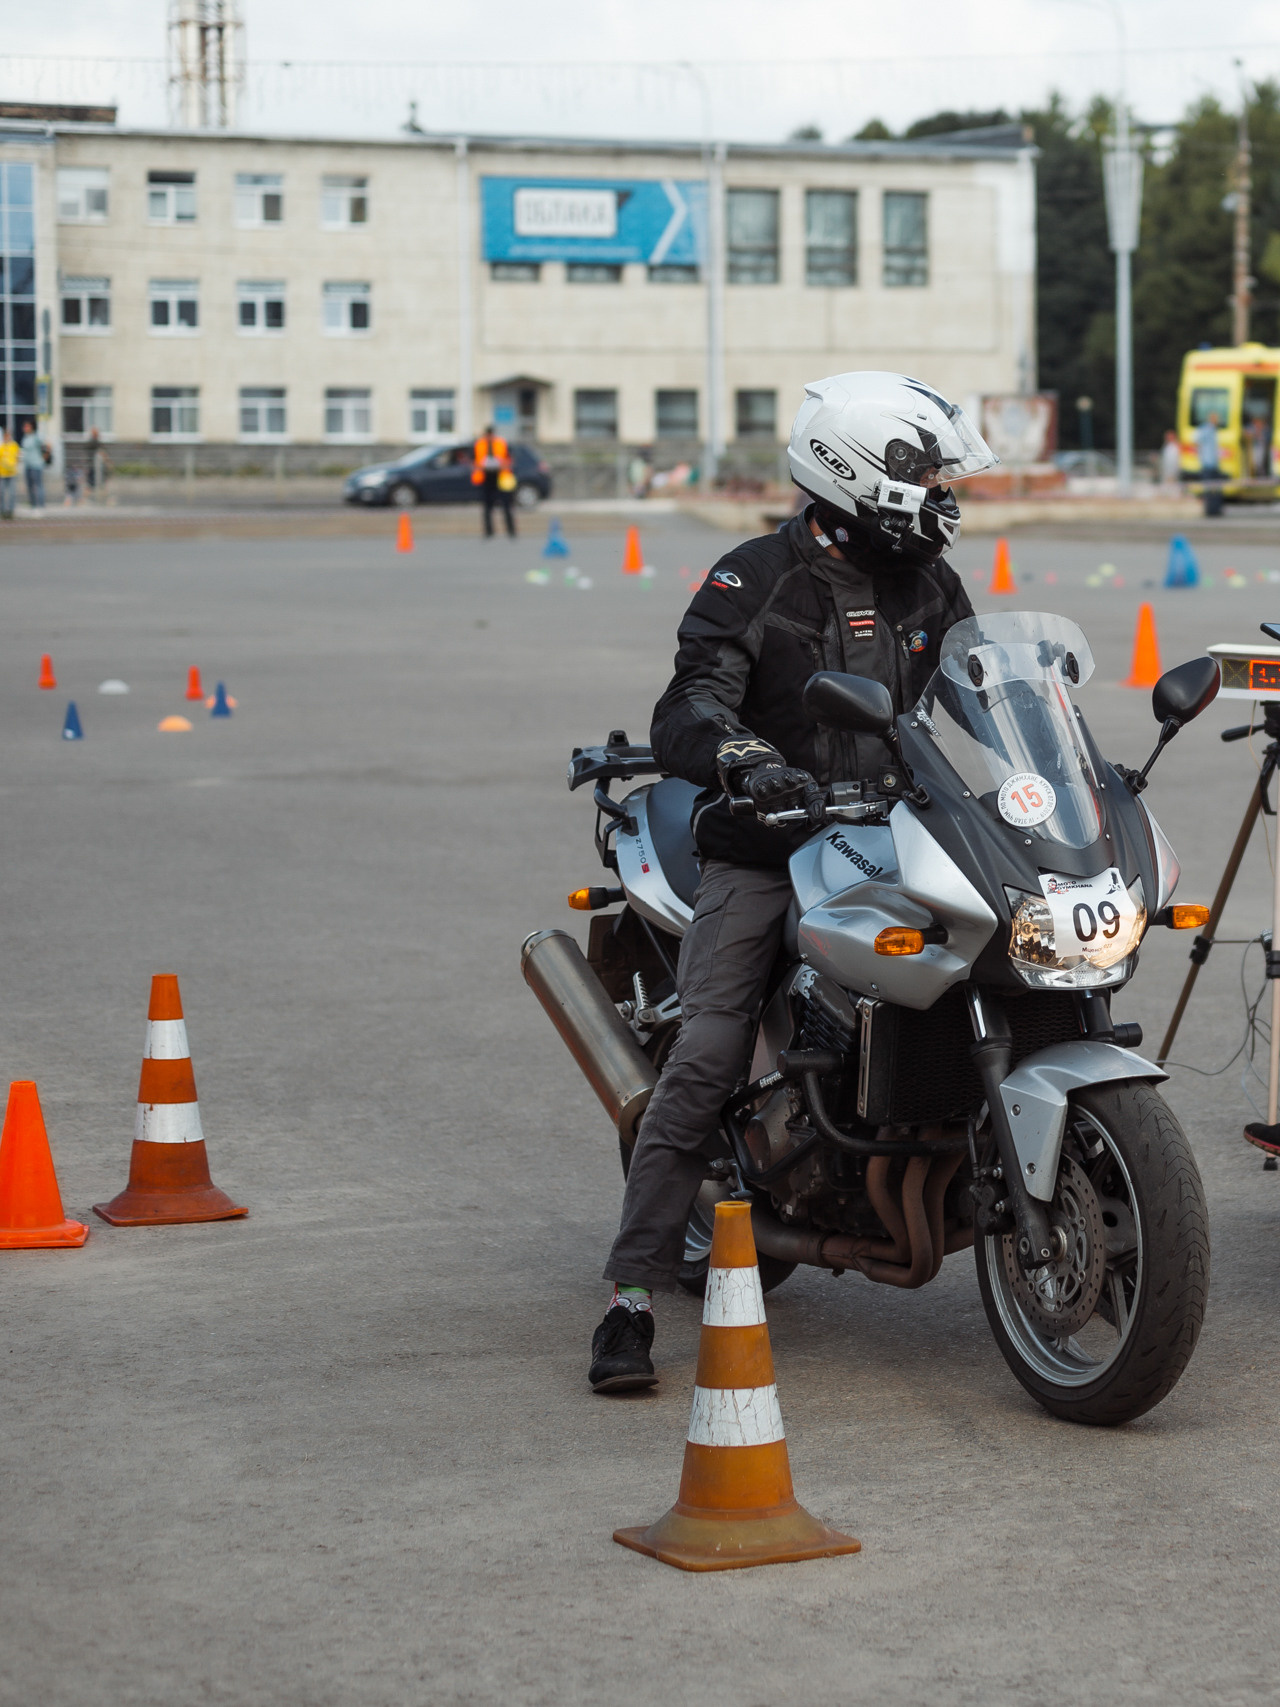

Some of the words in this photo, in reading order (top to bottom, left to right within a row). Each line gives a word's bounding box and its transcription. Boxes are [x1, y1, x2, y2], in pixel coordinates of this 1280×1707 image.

[813, 444, 851, 475] HJC
[1010, 783, 1043, 813] 15
[1072, 900, 1121, 942] 09
